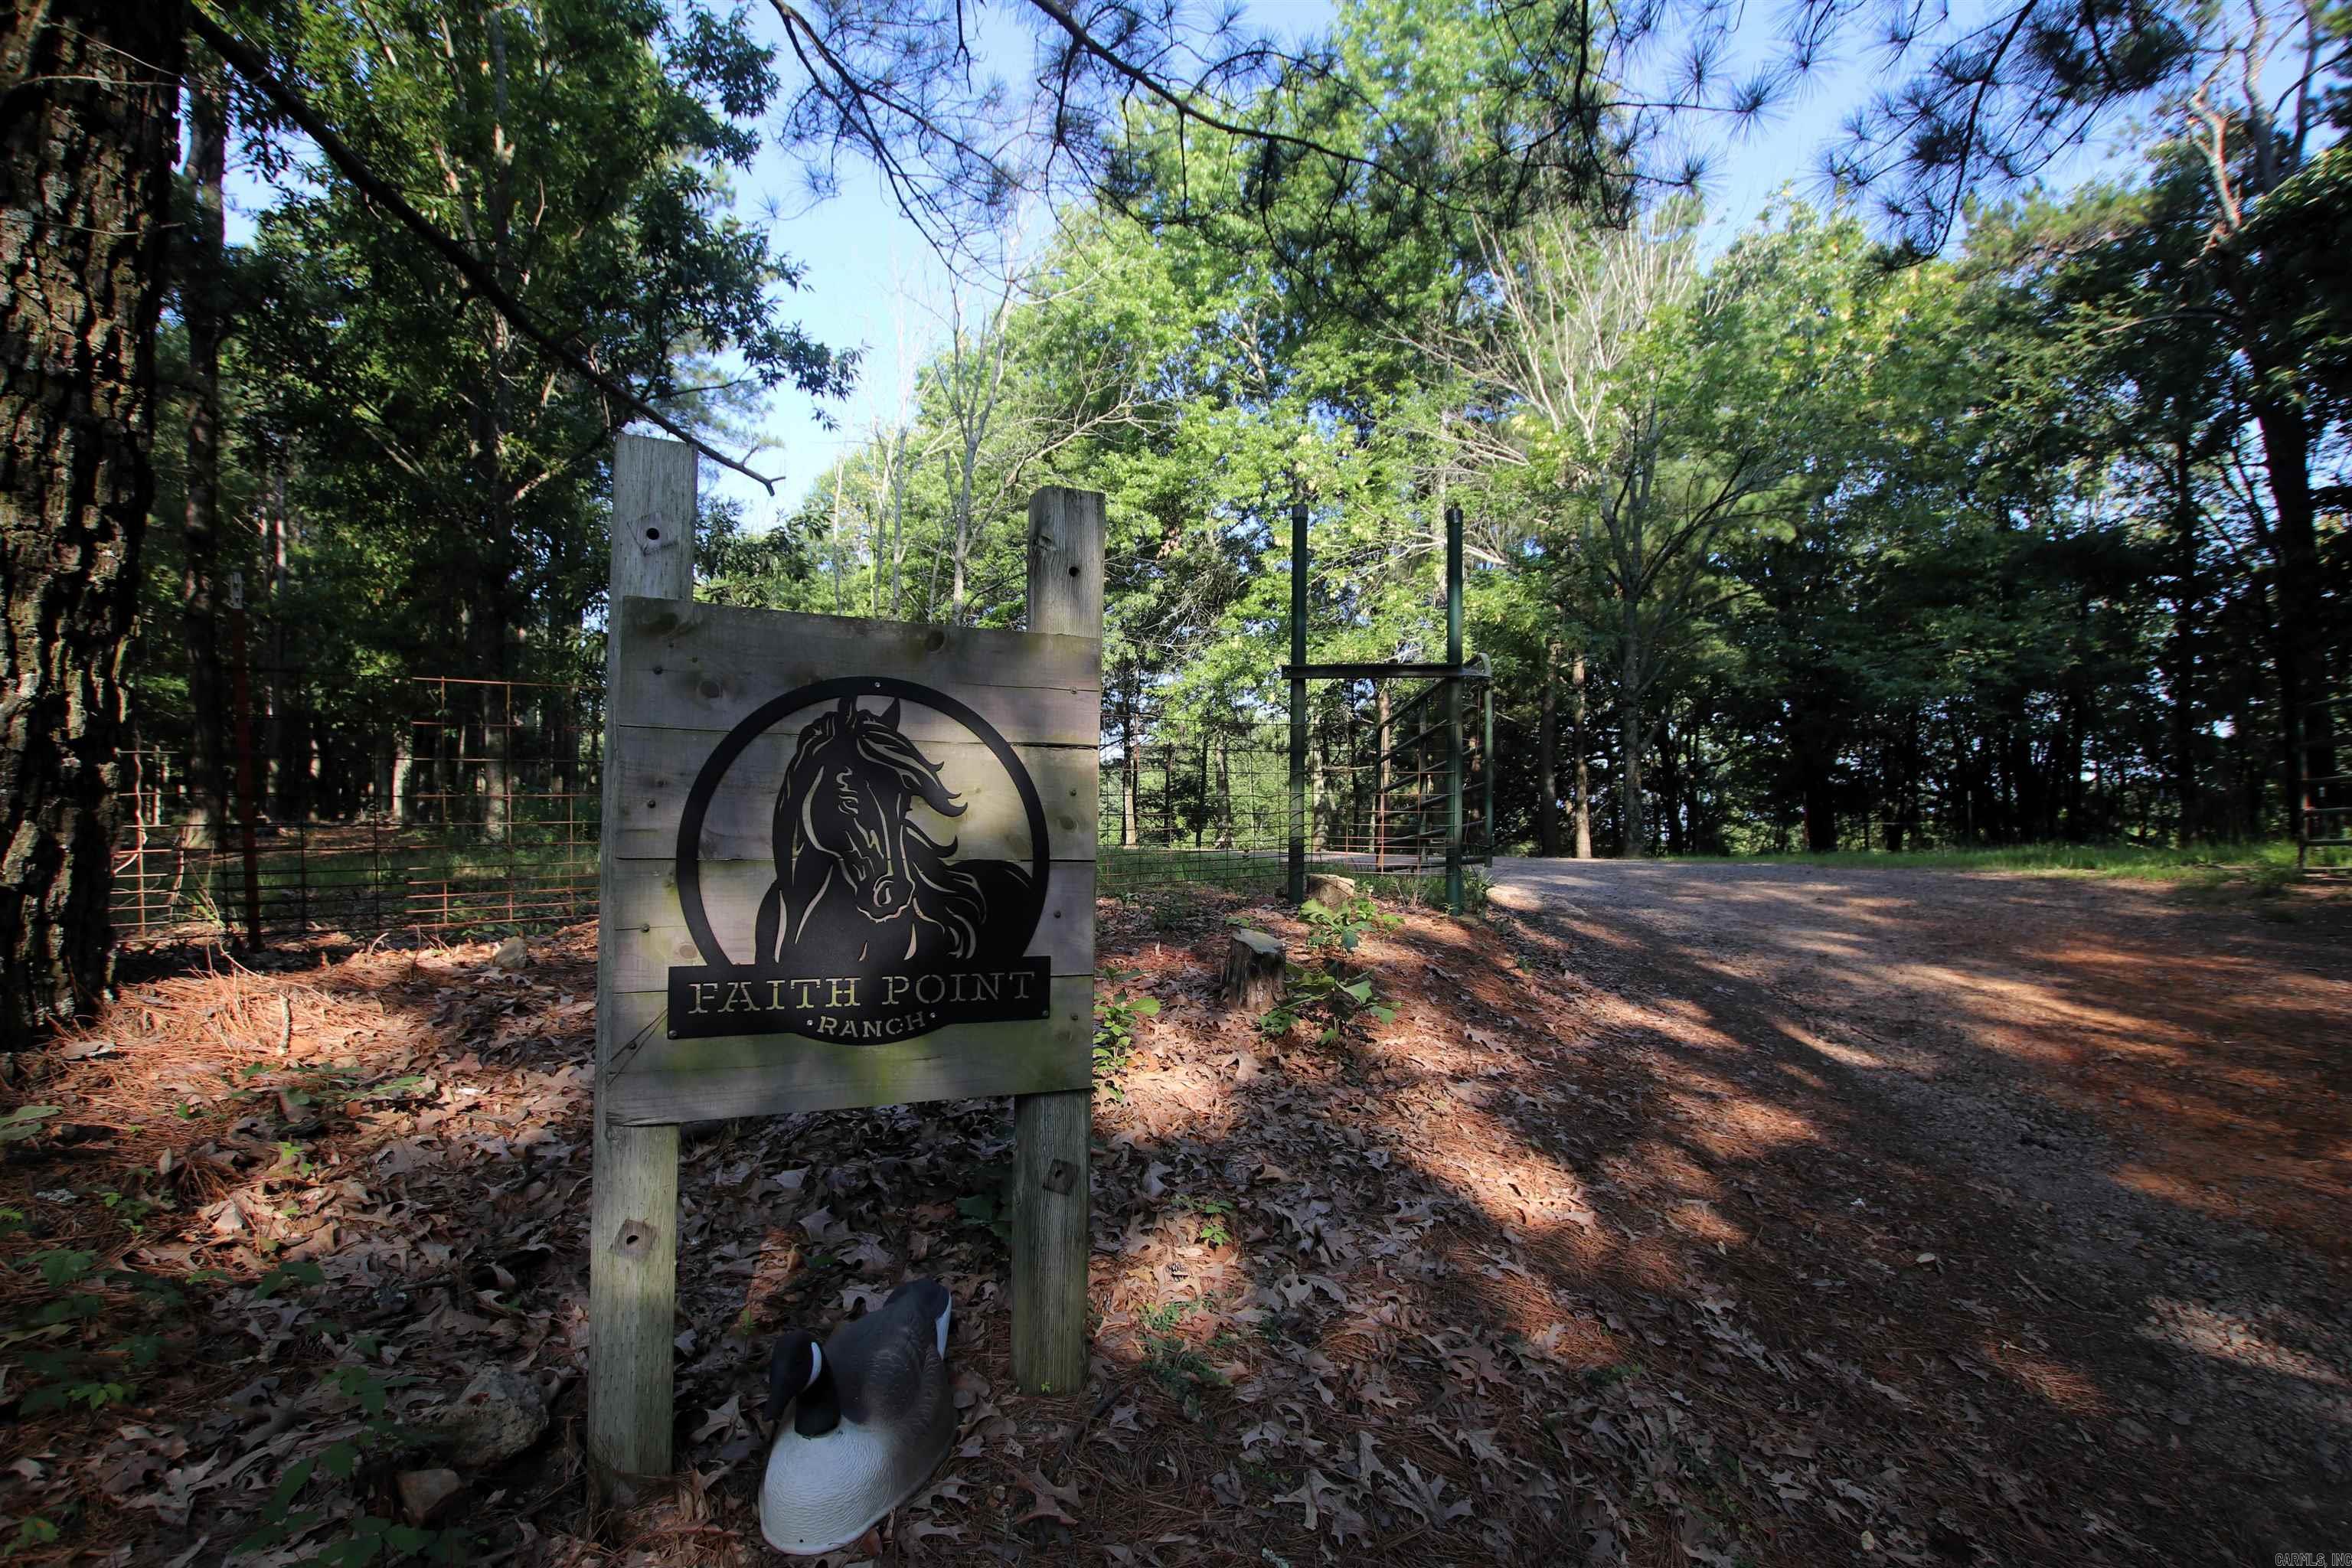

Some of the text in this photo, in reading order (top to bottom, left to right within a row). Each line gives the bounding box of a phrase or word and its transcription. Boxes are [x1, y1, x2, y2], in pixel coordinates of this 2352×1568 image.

[688, 971, 1036, 1014] FAITH POINT
[816, 1011, 926, 1038] RANCH
